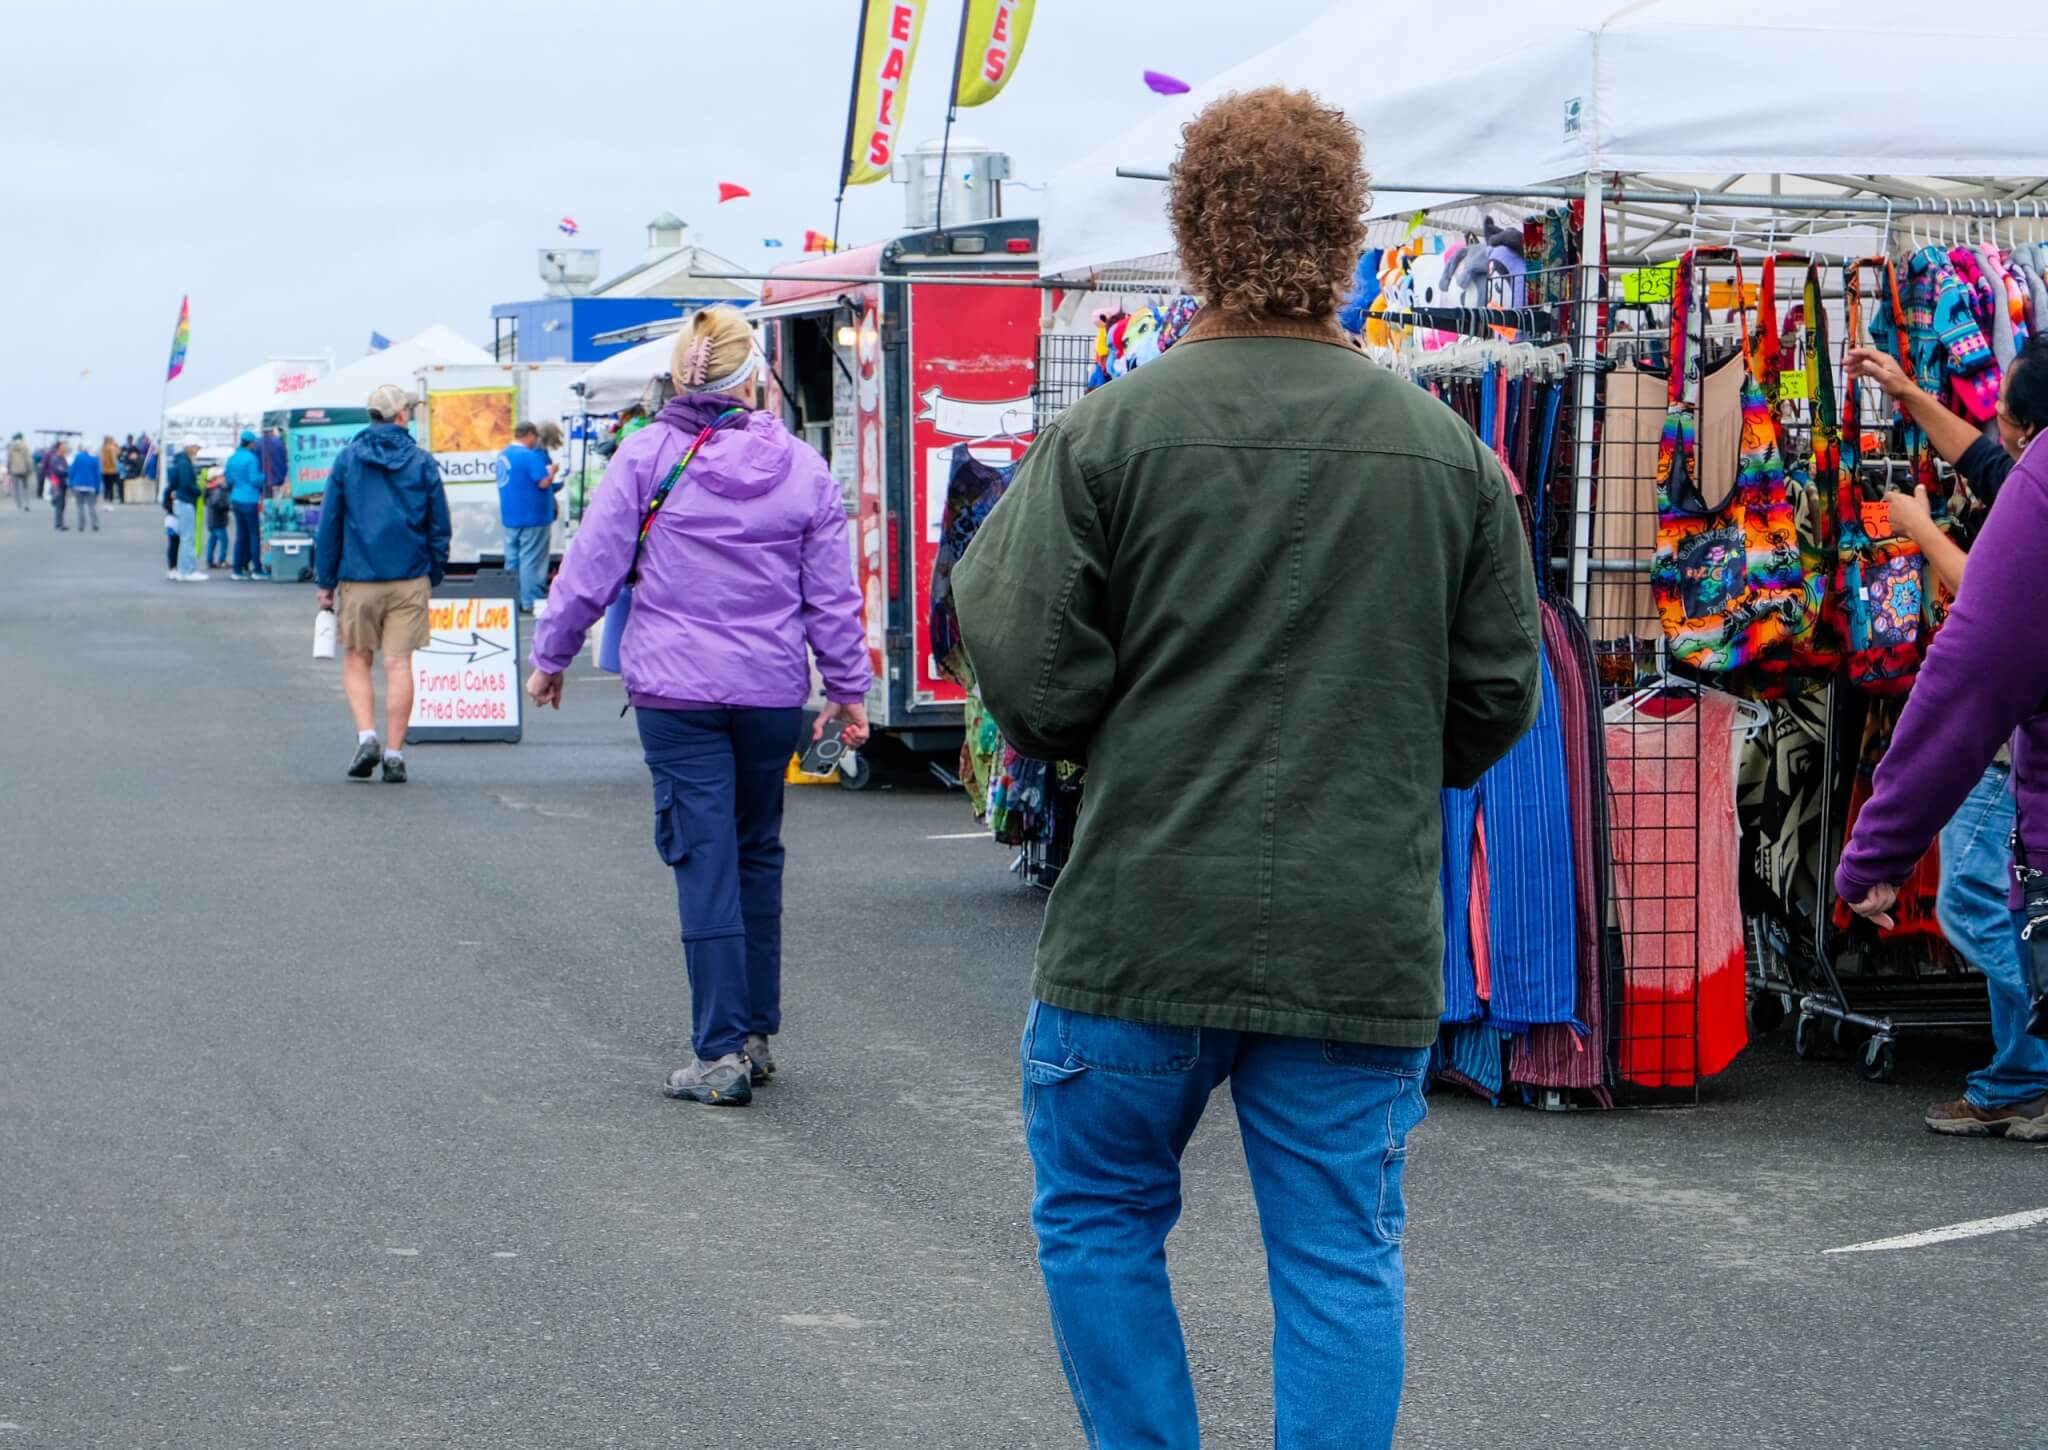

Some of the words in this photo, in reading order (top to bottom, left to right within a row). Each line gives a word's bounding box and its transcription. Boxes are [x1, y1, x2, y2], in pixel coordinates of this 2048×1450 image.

[984, 0, 1014, 82] ES
[457, 598, 473, 630] of
[476, 599, 509, 630] Love
[419, 670, 461, 692] Funnel
[464, 669, 506, 692] Cakes
[419, 698, 453, 720] Fried
[456, 698, 506, 720] Goodies
